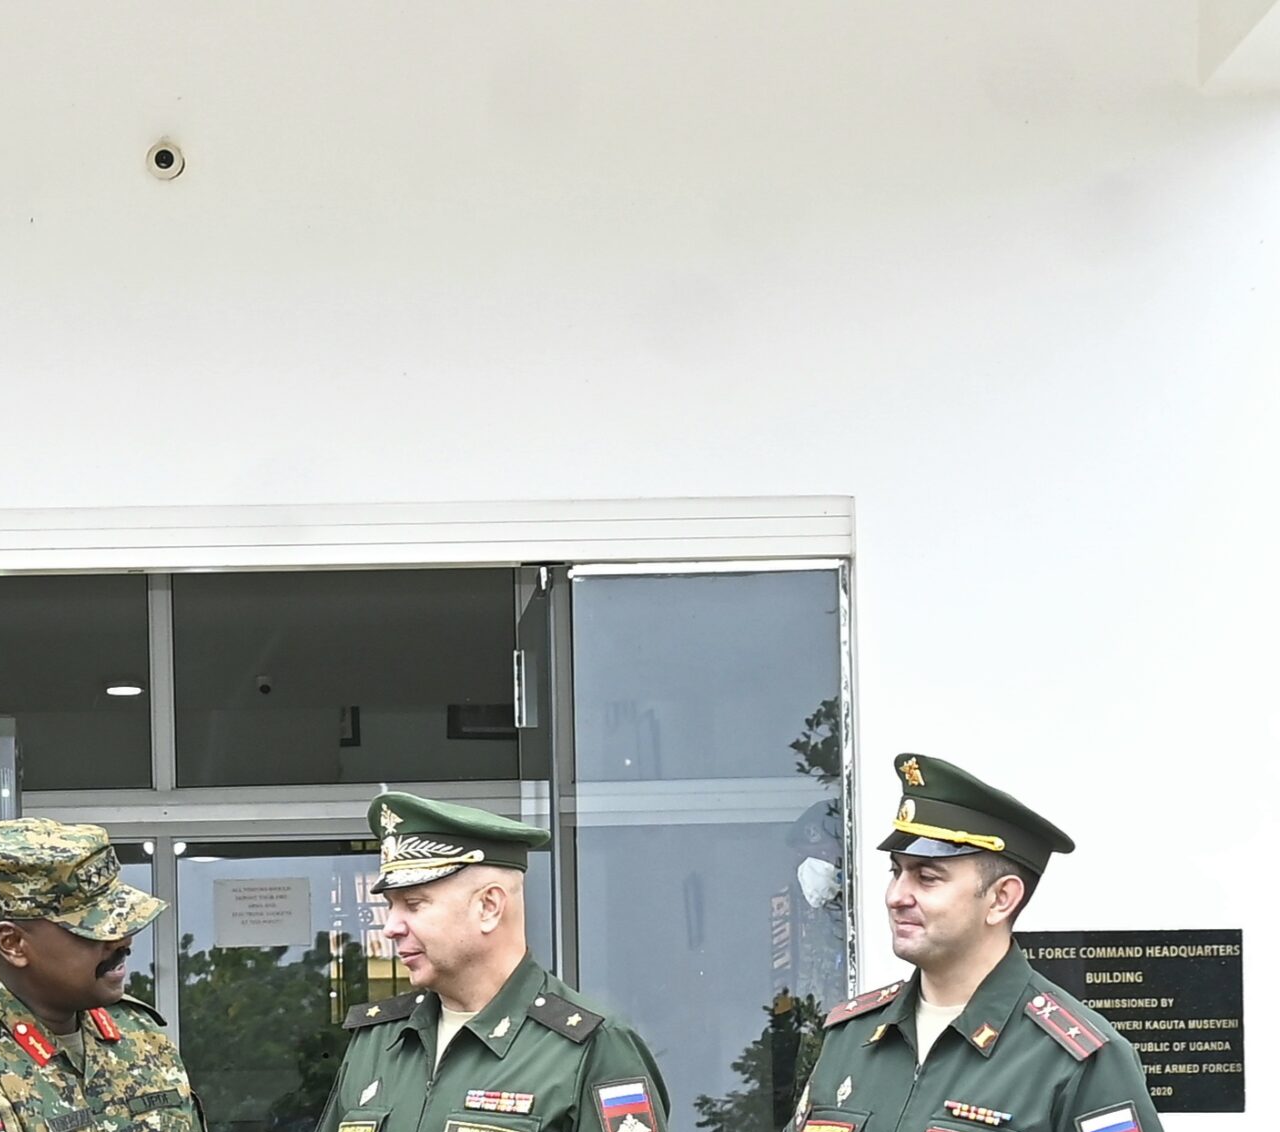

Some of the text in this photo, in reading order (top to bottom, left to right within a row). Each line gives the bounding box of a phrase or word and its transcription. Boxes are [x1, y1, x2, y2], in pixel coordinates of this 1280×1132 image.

[1038, 947, 1077, 959] FORCE
[1079, 945, 1143, 958] COMMAND
[1145, 944, 1241, 958] HEADQUARTERS
[1085, 971, 1144, 984] BUILDING
[1081, 997, 1175, 1009] COMMISSIONED BY
[1110, 1018, 1239, 1031] OWERI KAGUTA MUSEVENI
[1132, 1041, 1232, 1053] PUBLIC OF UGANDA
[1143, 1062, 1243, 1074] THE ARMED FORCES
[1150, 1086, 1173, 1097] 2020
